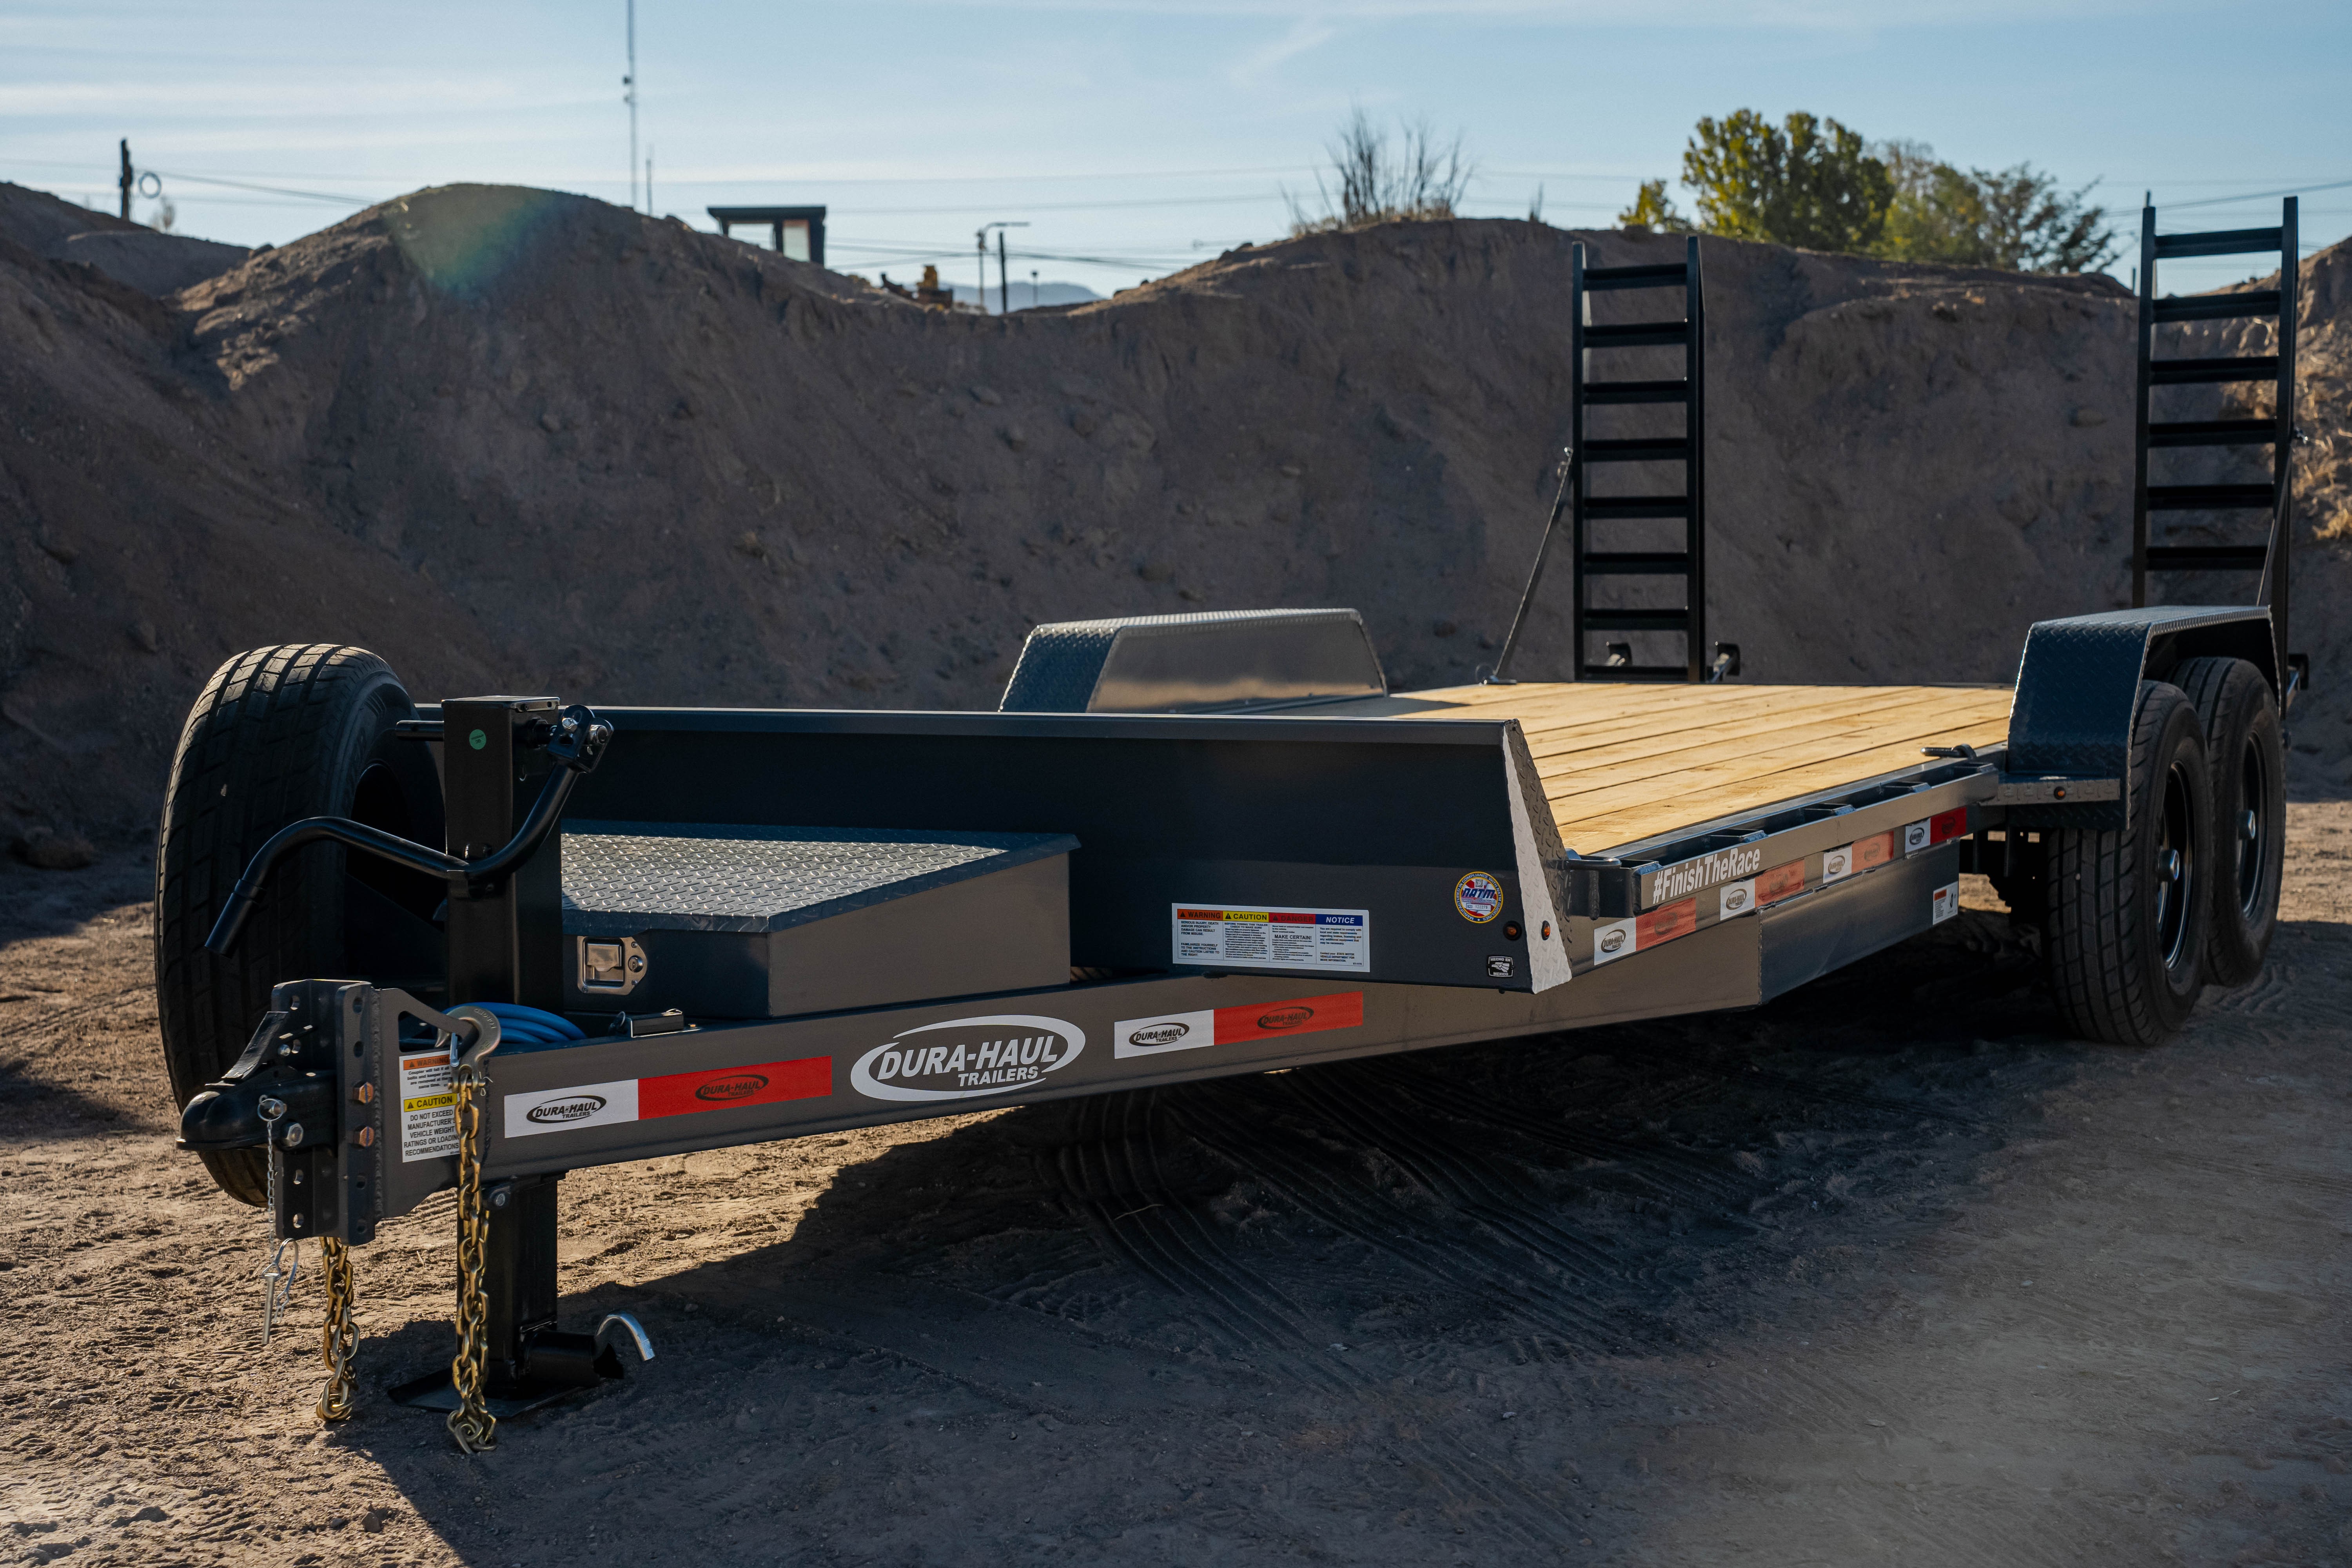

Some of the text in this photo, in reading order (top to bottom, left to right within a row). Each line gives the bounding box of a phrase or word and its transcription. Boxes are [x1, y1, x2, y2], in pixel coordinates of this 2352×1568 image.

[1462, 873, 1488, 883] COMPLIANCE
[1653, 848, 1760, 904] #FinishTheRace
[1488, 877, 1498, 889] WITH
[1456, 889, 1474, 920] MANUFACTURED
[1483, 902, 1501, 921] GUIDELINES
[1263, 1012, 1307, 1024] DURA-HAUL
[1135, 1028, 1182, 1041] DURA-HAUL
[417, 1056, 449, 1066] WARNING
[877, 1036, 1058, 1080] DURA-HAUL
[958, 1066, 1038, 1087] TRAILERS
[703, 1081, 760, 1095] DURA-HAUL
[417, 1096, 452, 1107] CAUTION
[432, 1109, 453, 1118] EXCEED
[535, 1102, 597, 1118] DURA-HAUL
[410, 1126, 455, 1138] VEHICLE WEIGHT
[404, 1139, 426, 1148] RATINGS
[405, 1143, 459, 1156] RECOMMENDATIONS
